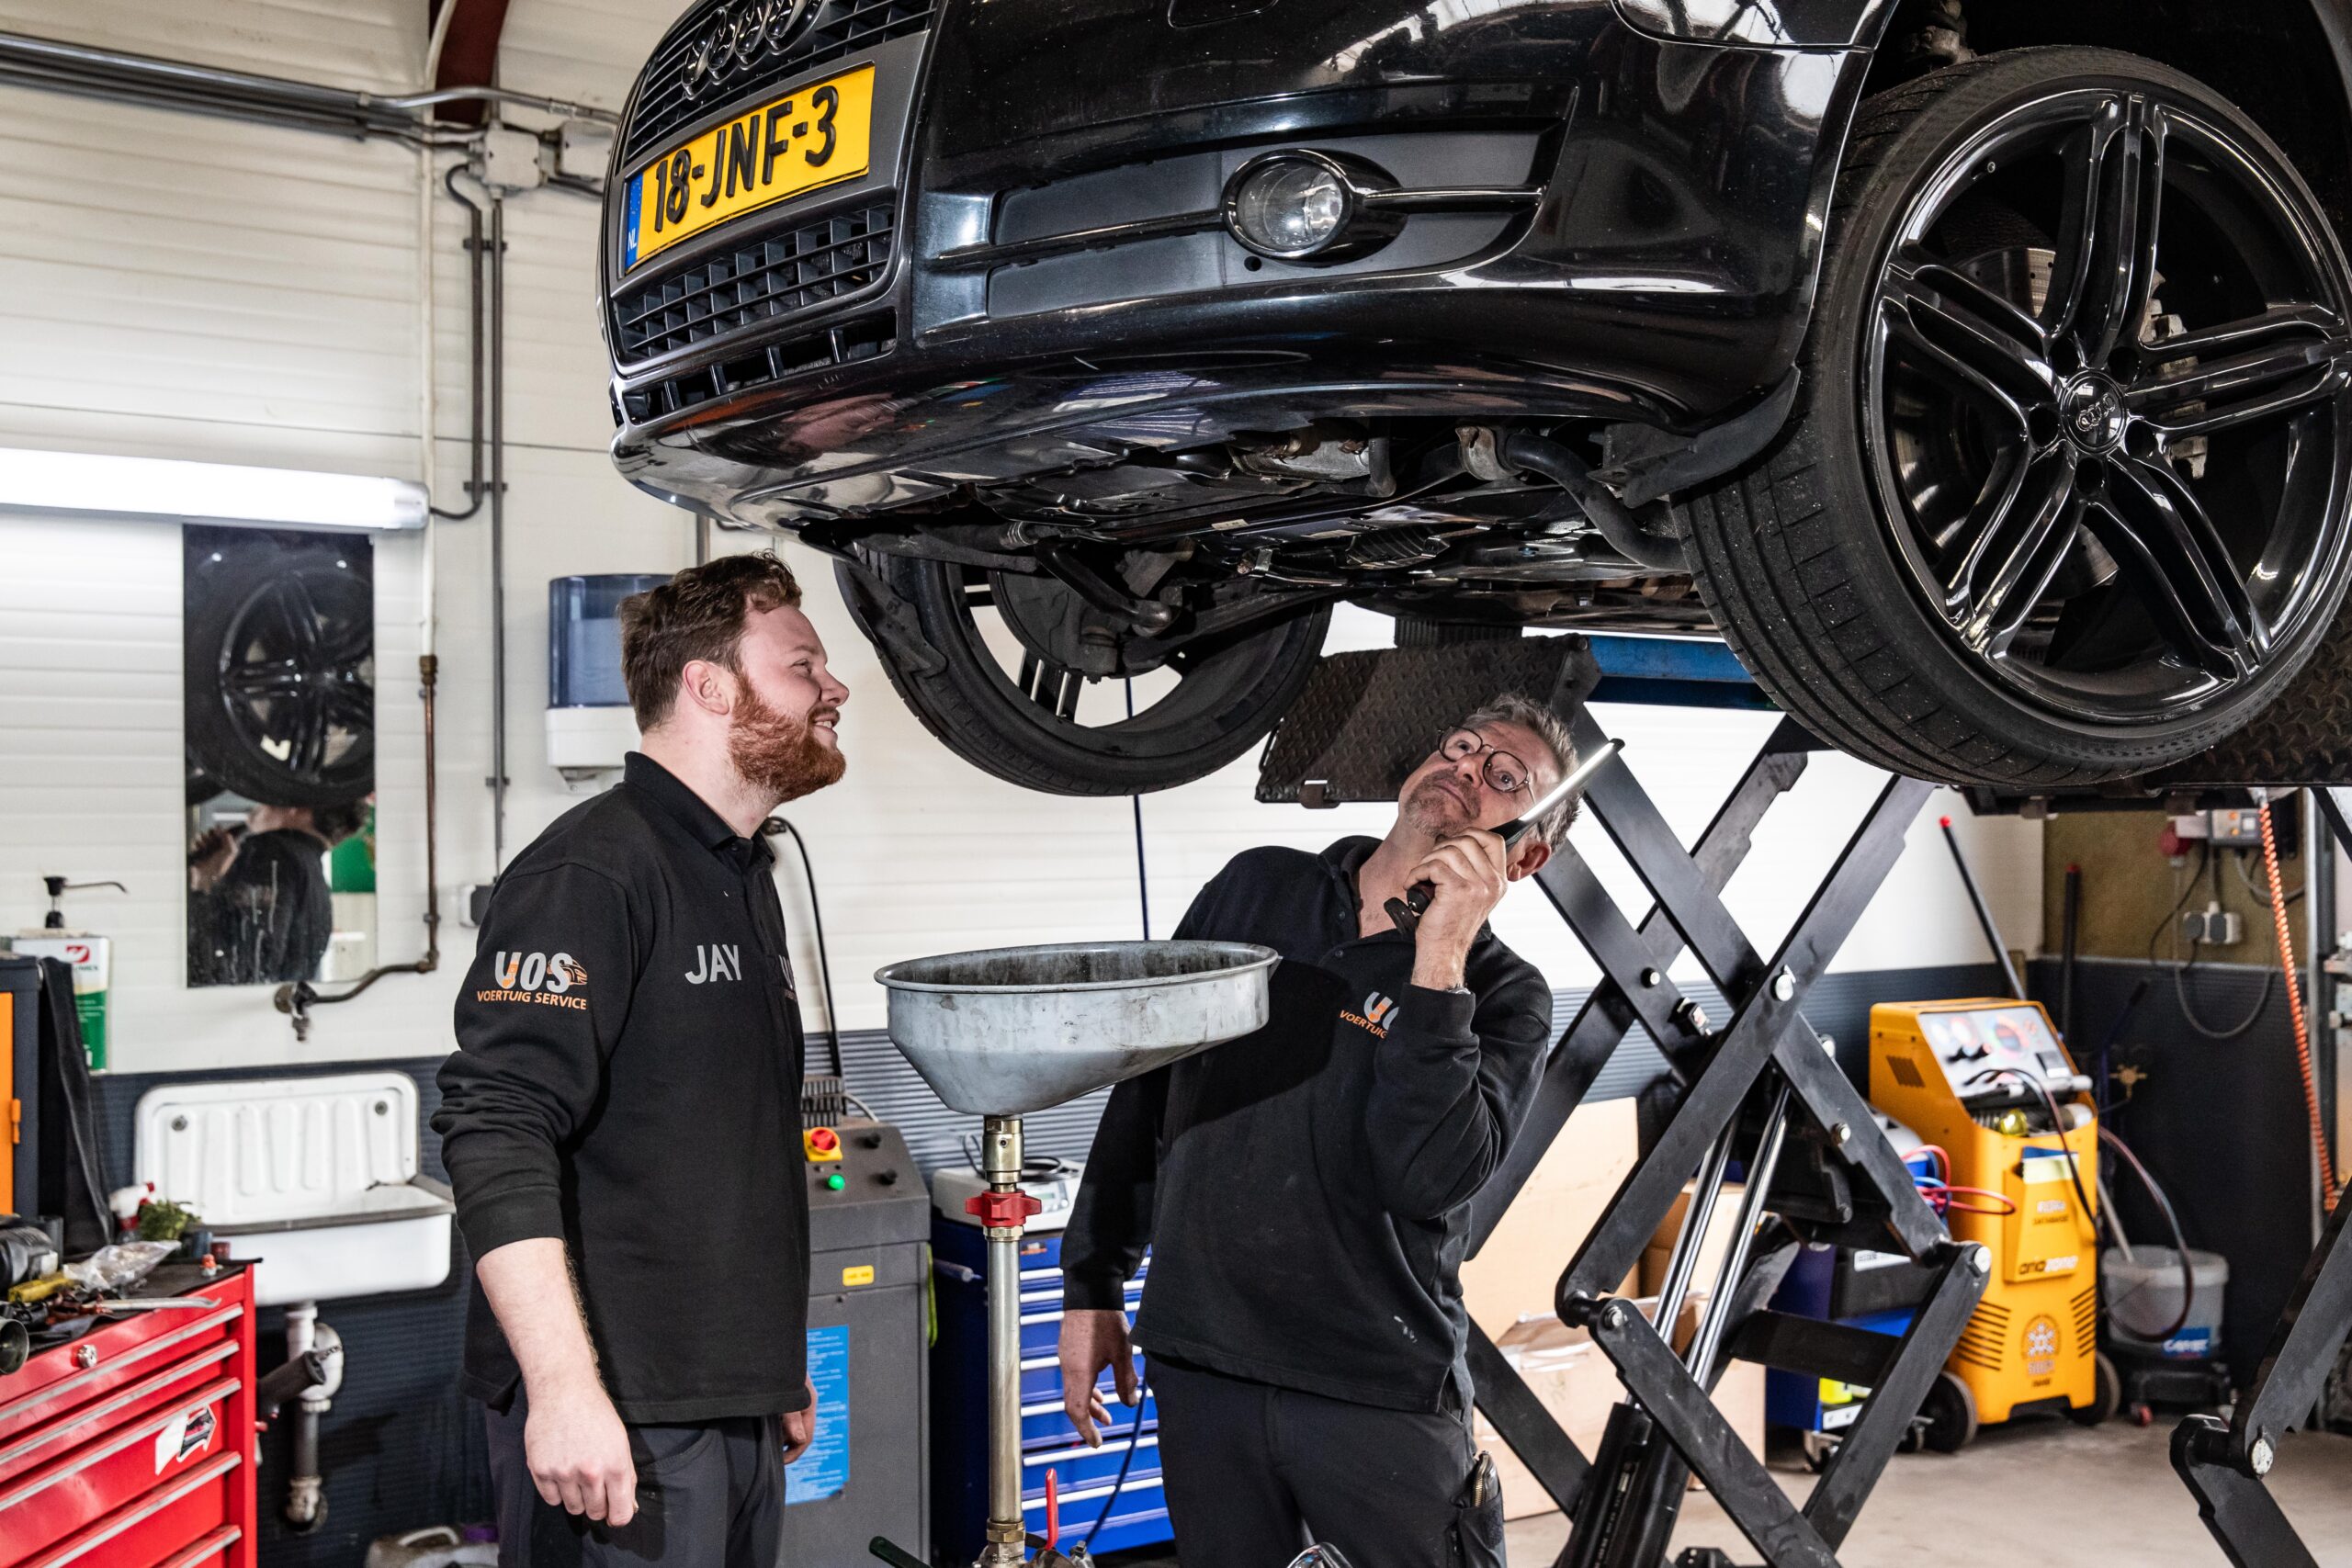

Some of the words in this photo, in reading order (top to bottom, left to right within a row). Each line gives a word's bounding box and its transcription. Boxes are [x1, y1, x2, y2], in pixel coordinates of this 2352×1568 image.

[653, 85, 839, 233] 18-JNF-3
[628, 227, 638, 253] NL
[684, 943, 742, 985] JAY
[477, 989, 532, 1003] VOERTUIG
[534, 992, 587, 1010] SERVICE
